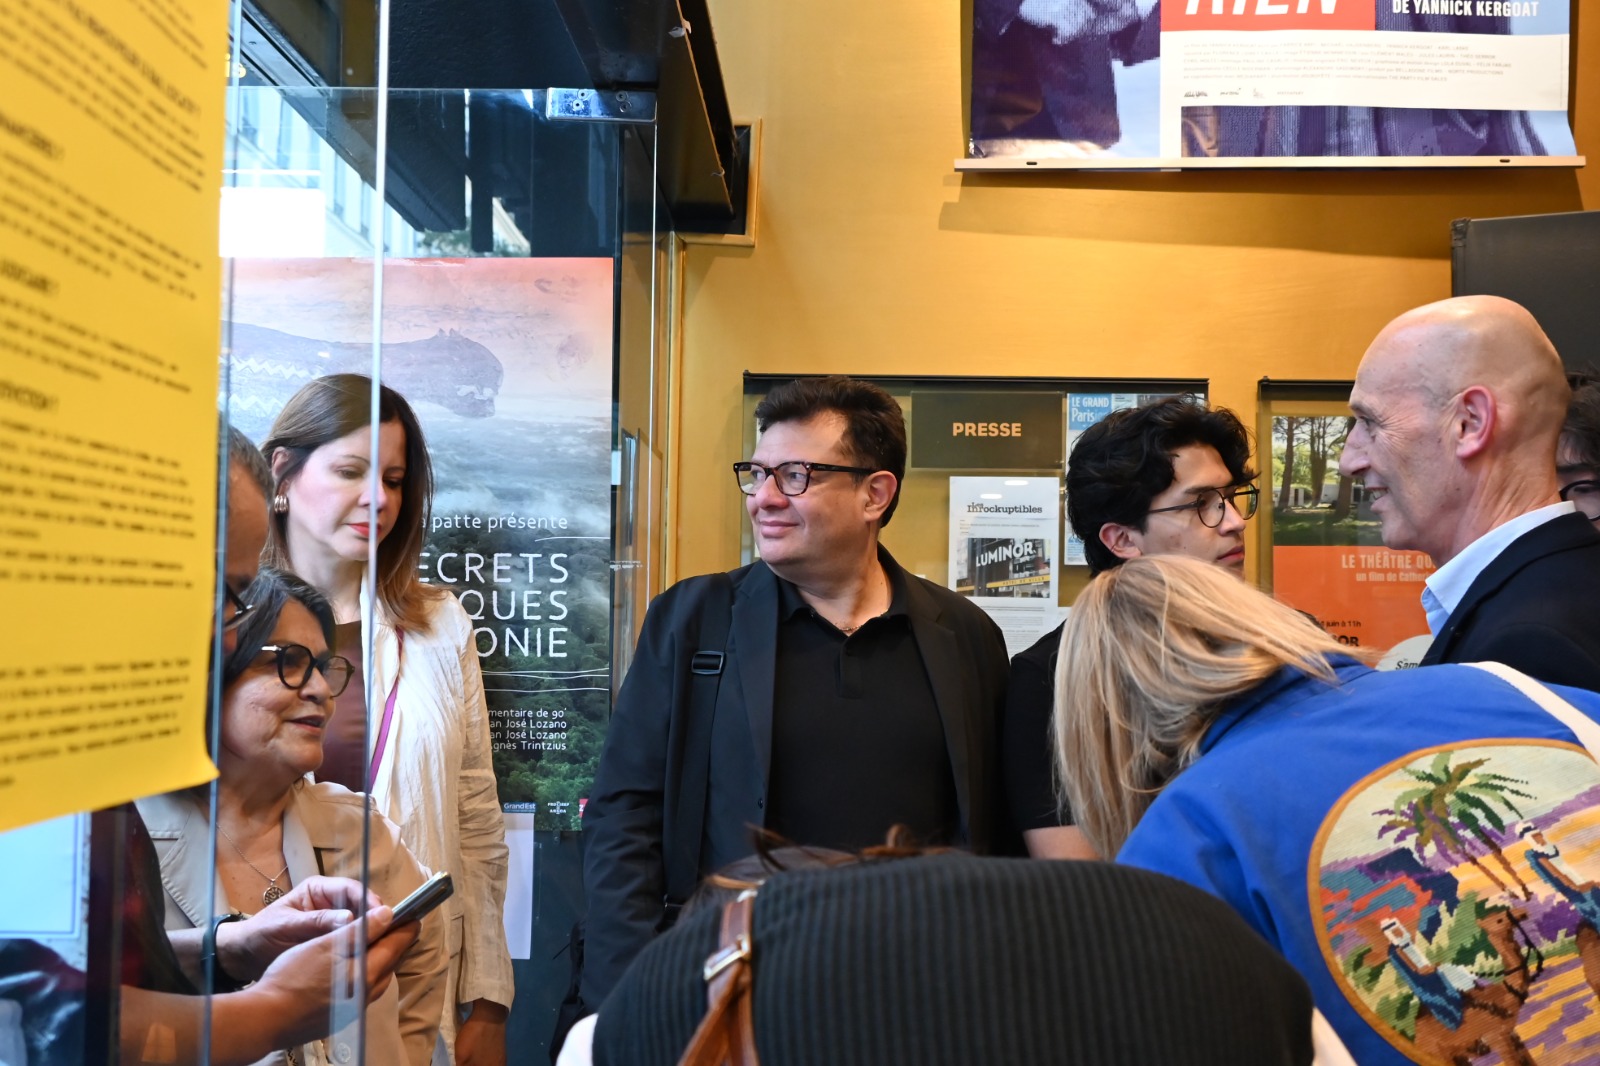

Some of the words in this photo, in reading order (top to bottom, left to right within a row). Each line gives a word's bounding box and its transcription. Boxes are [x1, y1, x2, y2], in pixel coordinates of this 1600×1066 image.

[1392, 0, 1410, 14] DE
[1414, 0, 1472, 16] YANNICK
[1476, 2, 1539, 17] KERGOAT
[1072, 397, 1080, 407] LE
[1082, 397, 1109, 408] GRAND
[952, 422, 1022, 436] PRESSE
[432, 514, 482, 532] patte
[488, 512, 568, 533] présente
[976, 542, 1034, 567] LUMINOR
[1341, 554, 1356, 568] LE
[1360, 551, 1411, 568] THÉÂTRE
[1416, 554, 1436, 569] QU
[1356, 572, 1367, 582] un
[1369, 572, 1384, 582] film
[1387, 572, 1397, 582] de
[459, 590, 568, 621] QUES
[475, 627, 568, 657] ONIE
[536, 708, 548, 717] de
[506, 718, 526, 728] José
[530, 720, 566, 728] Lozano
[506, 728, 526, 739] José
[530, 730, 566, 739] Lozano
[491, 740, 517, 752] gnès
[521, 741, 566, 750] Trintzius
